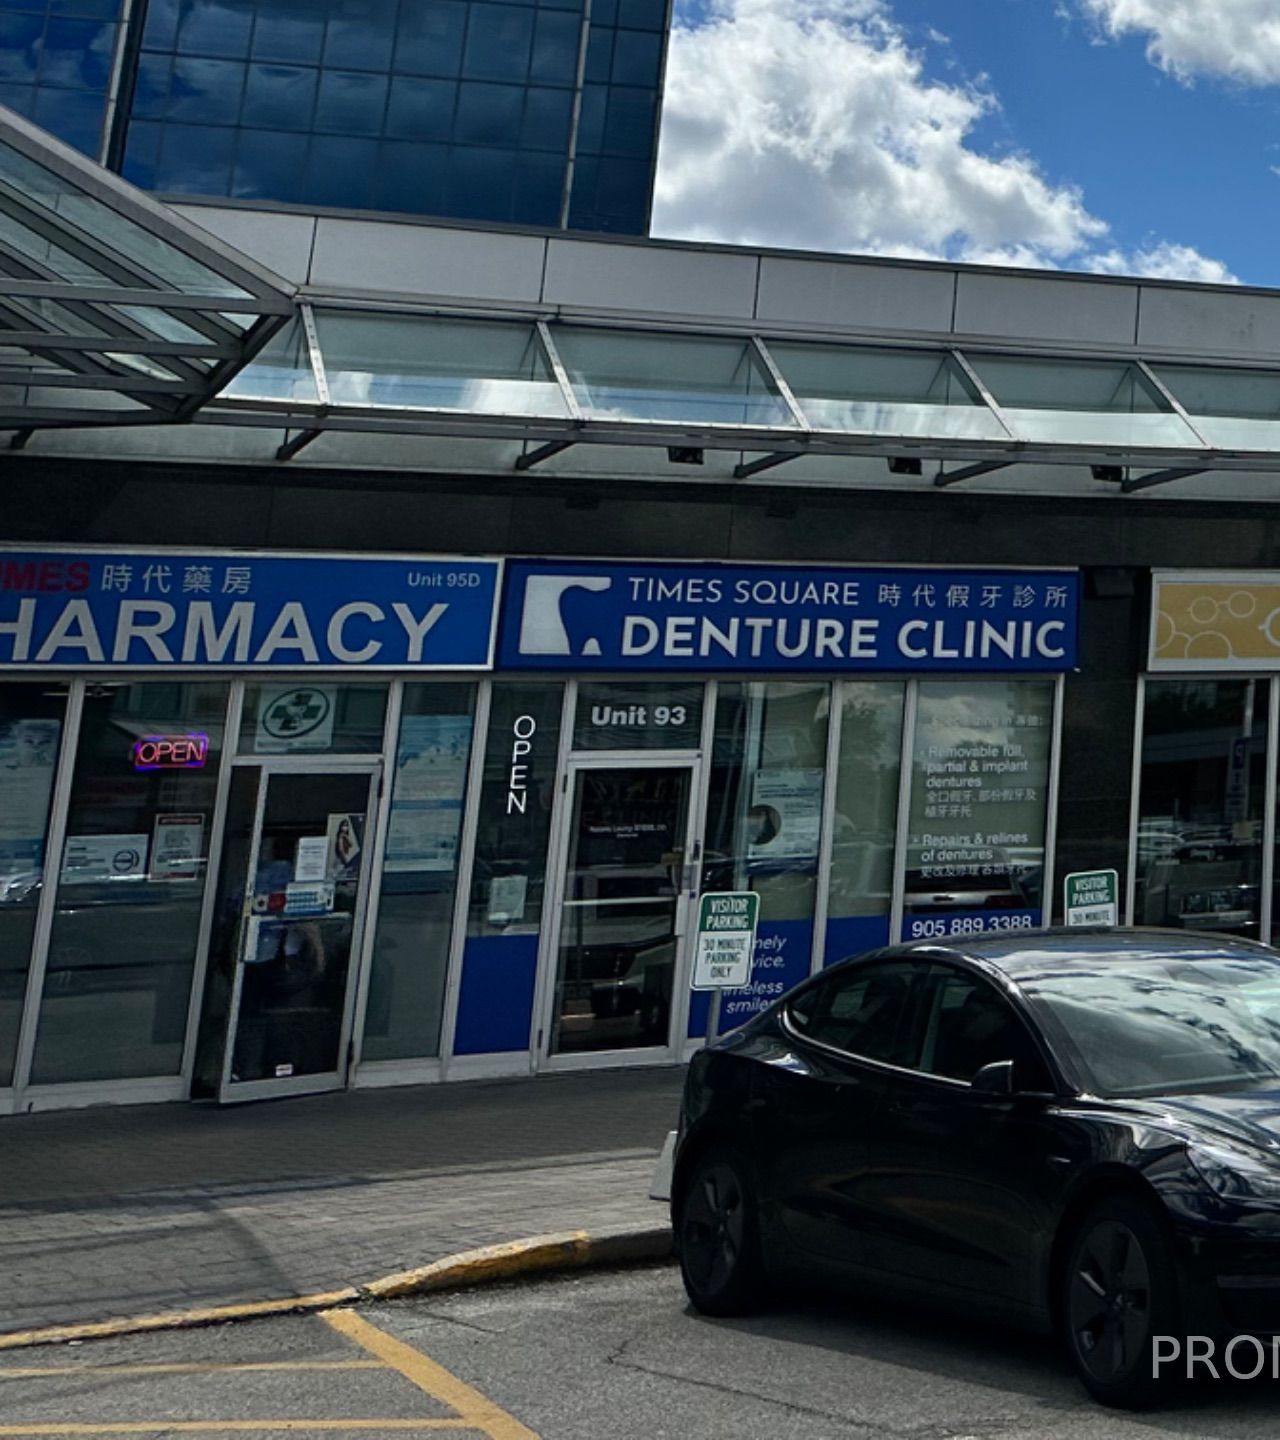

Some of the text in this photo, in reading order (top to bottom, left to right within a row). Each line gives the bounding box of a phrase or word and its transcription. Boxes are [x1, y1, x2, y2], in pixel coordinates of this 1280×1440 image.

[0, 560, 91, 593] MES
[101, 564, 253, 595] 時代藥房
[408, 571, 481, 588] Unit 95D
[629, 577, 860, 607] TIMES SQUARE
[877, 583, 1069, 609] 時代假牙診所
[621, 616, 1066, 660] DENTURE CLINIC
[591, 705, 686, 726] Unit 93
[138, 741, 205, 763] OPEN
[506, 715, 537, 815] OPEN
[969, 760, 979, 772] &
[922, 833, 970, 847] Repairs
[973, 833, 983, 846] &
[921, 848, 993, 862] of dentures
[1074, 876, 1108, 891] VISITOR
[711, 897, 749, 914] VISITOR
[1072, 889, 1111, 905] PARKING
[706, 914, 750, 930] PARKING
[912, 914, 1032, 938] 905 889 3388
[704, 951, 741, 965] PARKING
